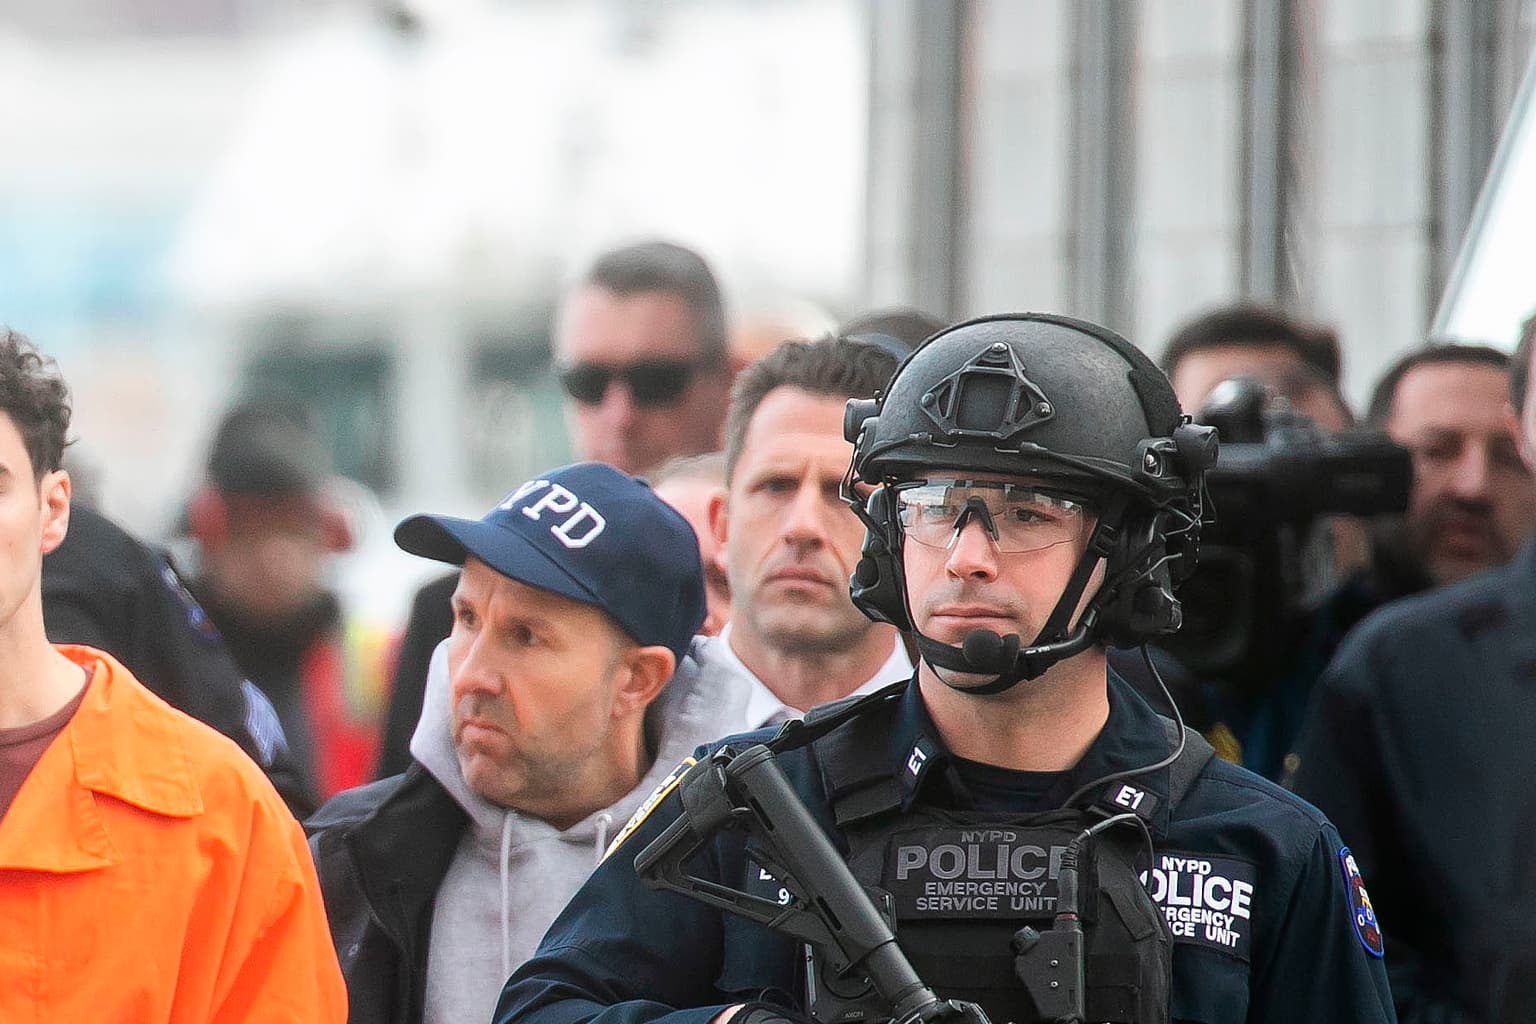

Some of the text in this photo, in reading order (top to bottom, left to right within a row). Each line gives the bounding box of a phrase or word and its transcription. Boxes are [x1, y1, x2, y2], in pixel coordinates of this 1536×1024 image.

[498, 479, 607, 549] YPD
[907, 746, 928, 776] E1
[1115, 784, 1145, 810] E1
[961, 830, 1017, 842] NYPD
[1161, 856, 1212, 875] NYPD
[924, 881, 1047, 896] EMERGENCY
[1139, 868, 1254, 920] OLICE
[916, 897, 1057, 911] SERVICE UNIT
[1160, 906, 1235, 931] RGENCY
[1205, 925, 1241, 948] UNIT
